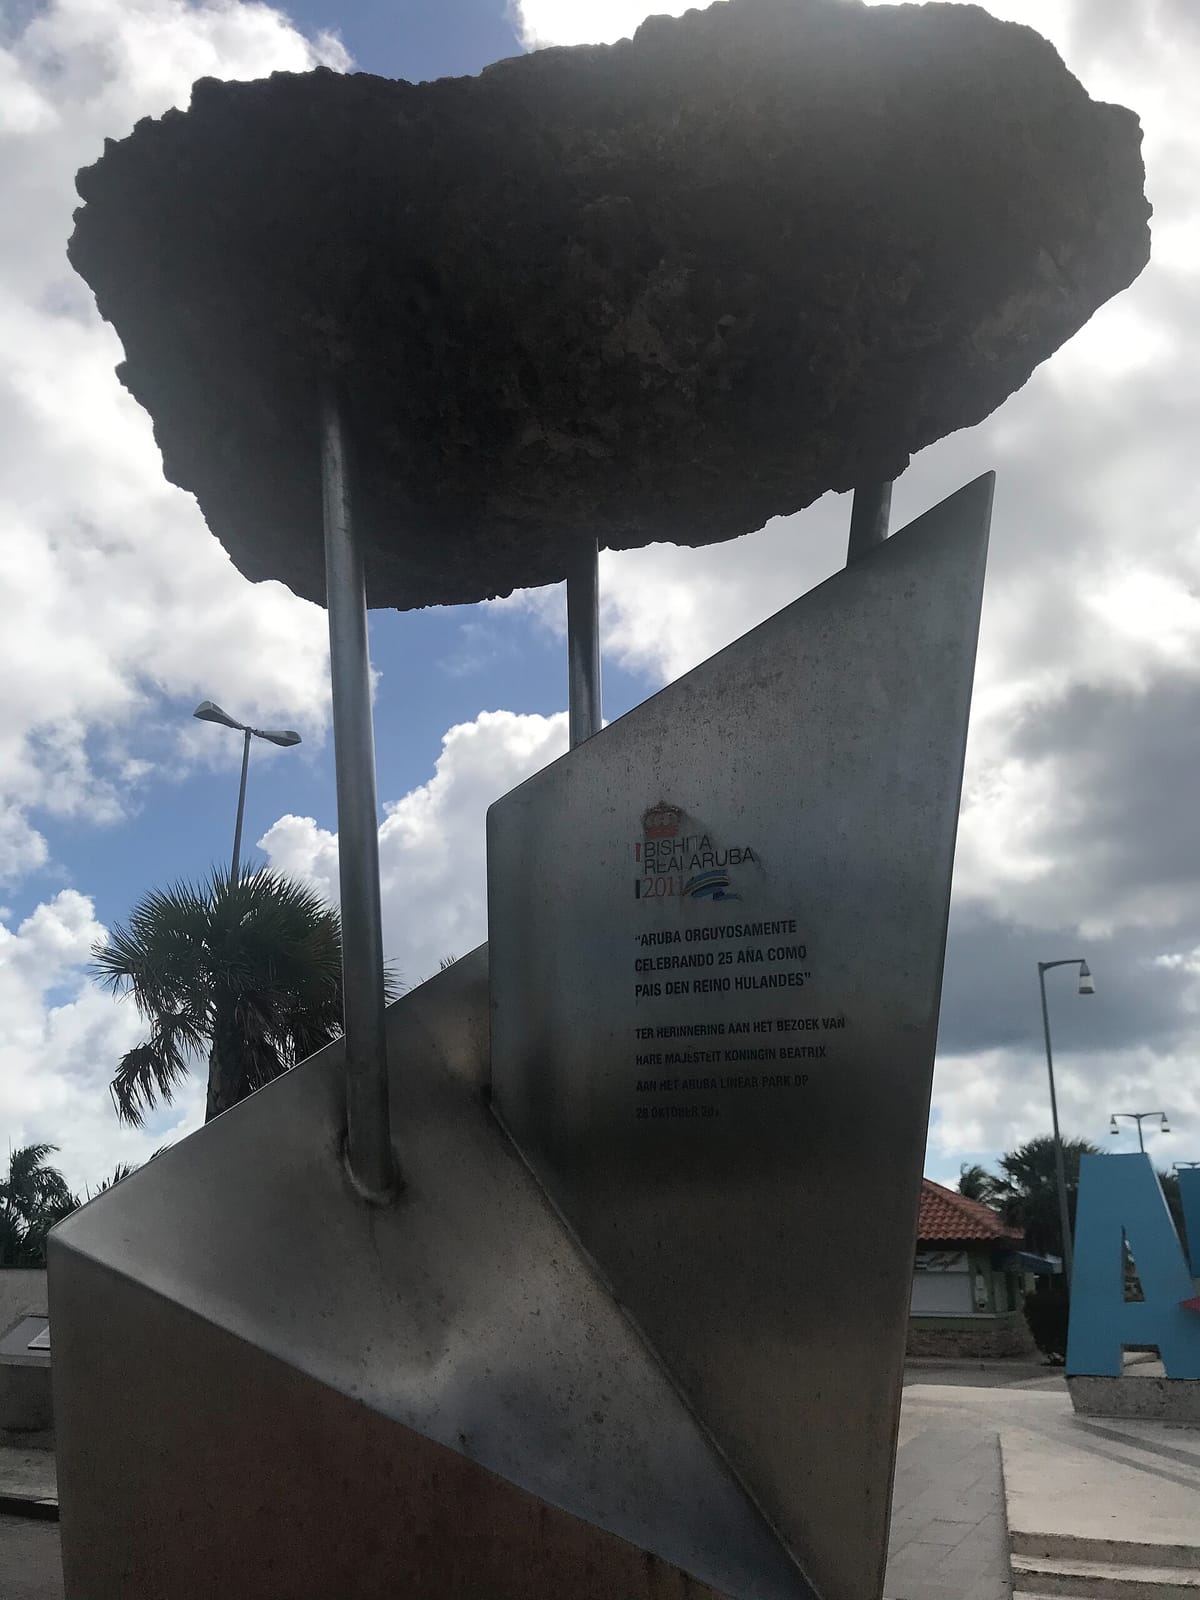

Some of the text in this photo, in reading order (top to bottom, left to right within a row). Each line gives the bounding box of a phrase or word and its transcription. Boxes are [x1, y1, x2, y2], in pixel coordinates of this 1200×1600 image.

[689, 847, 755, 870] ARUBA
[685, 919, 797, 942] ORGUYOSAMENTE
[635, 952, 714, 972] CELEBRANDO
[718, 951, 733, 966] 25
[767, 945, 807, 961] COMO
[635, 983, 661, 997] PAIS
[665, 981, 689, 995] DEN
[693, 977, 731, 994] REINO
[635, 1017, 846, 1040] TER HERINNERING AAN HET BEZOEK VAN
[635, 1045, 827, 1066] HARE MAJESTEIT KONINGIN BEATRIX
[636, 1074, 809, 1092] AAN HET ARUBA LINEAR PARK OP
